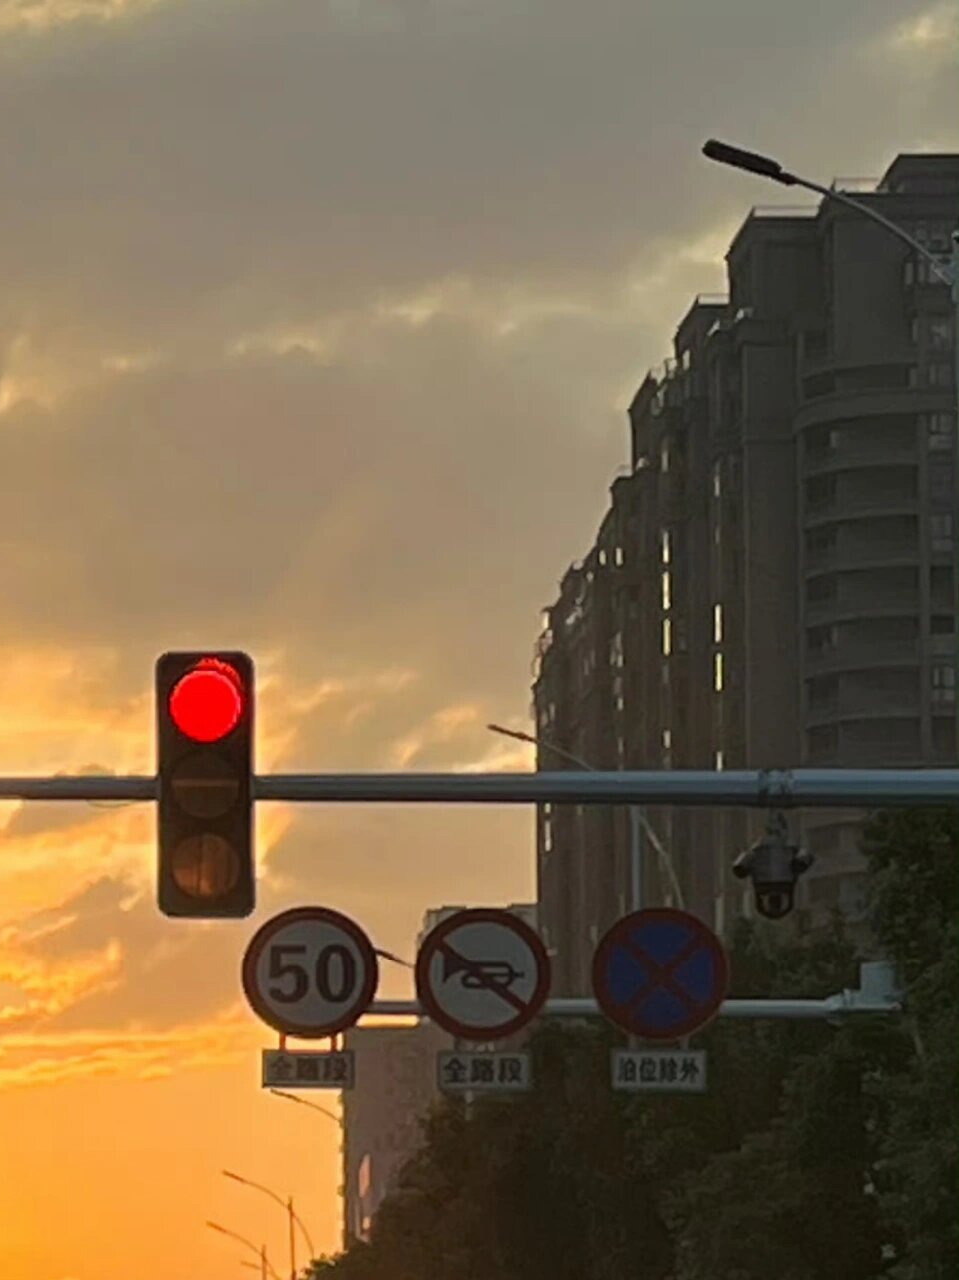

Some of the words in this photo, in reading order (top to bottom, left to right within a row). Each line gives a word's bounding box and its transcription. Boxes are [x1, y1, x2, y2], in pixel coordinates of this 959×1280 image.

[268, 943, 357, 1005] 50
[269, 1055, 349, 1081] 全路段
[443, 1055, 522, 1083] 全路段
[617, 1056, 700, 1083] 泊位除外
